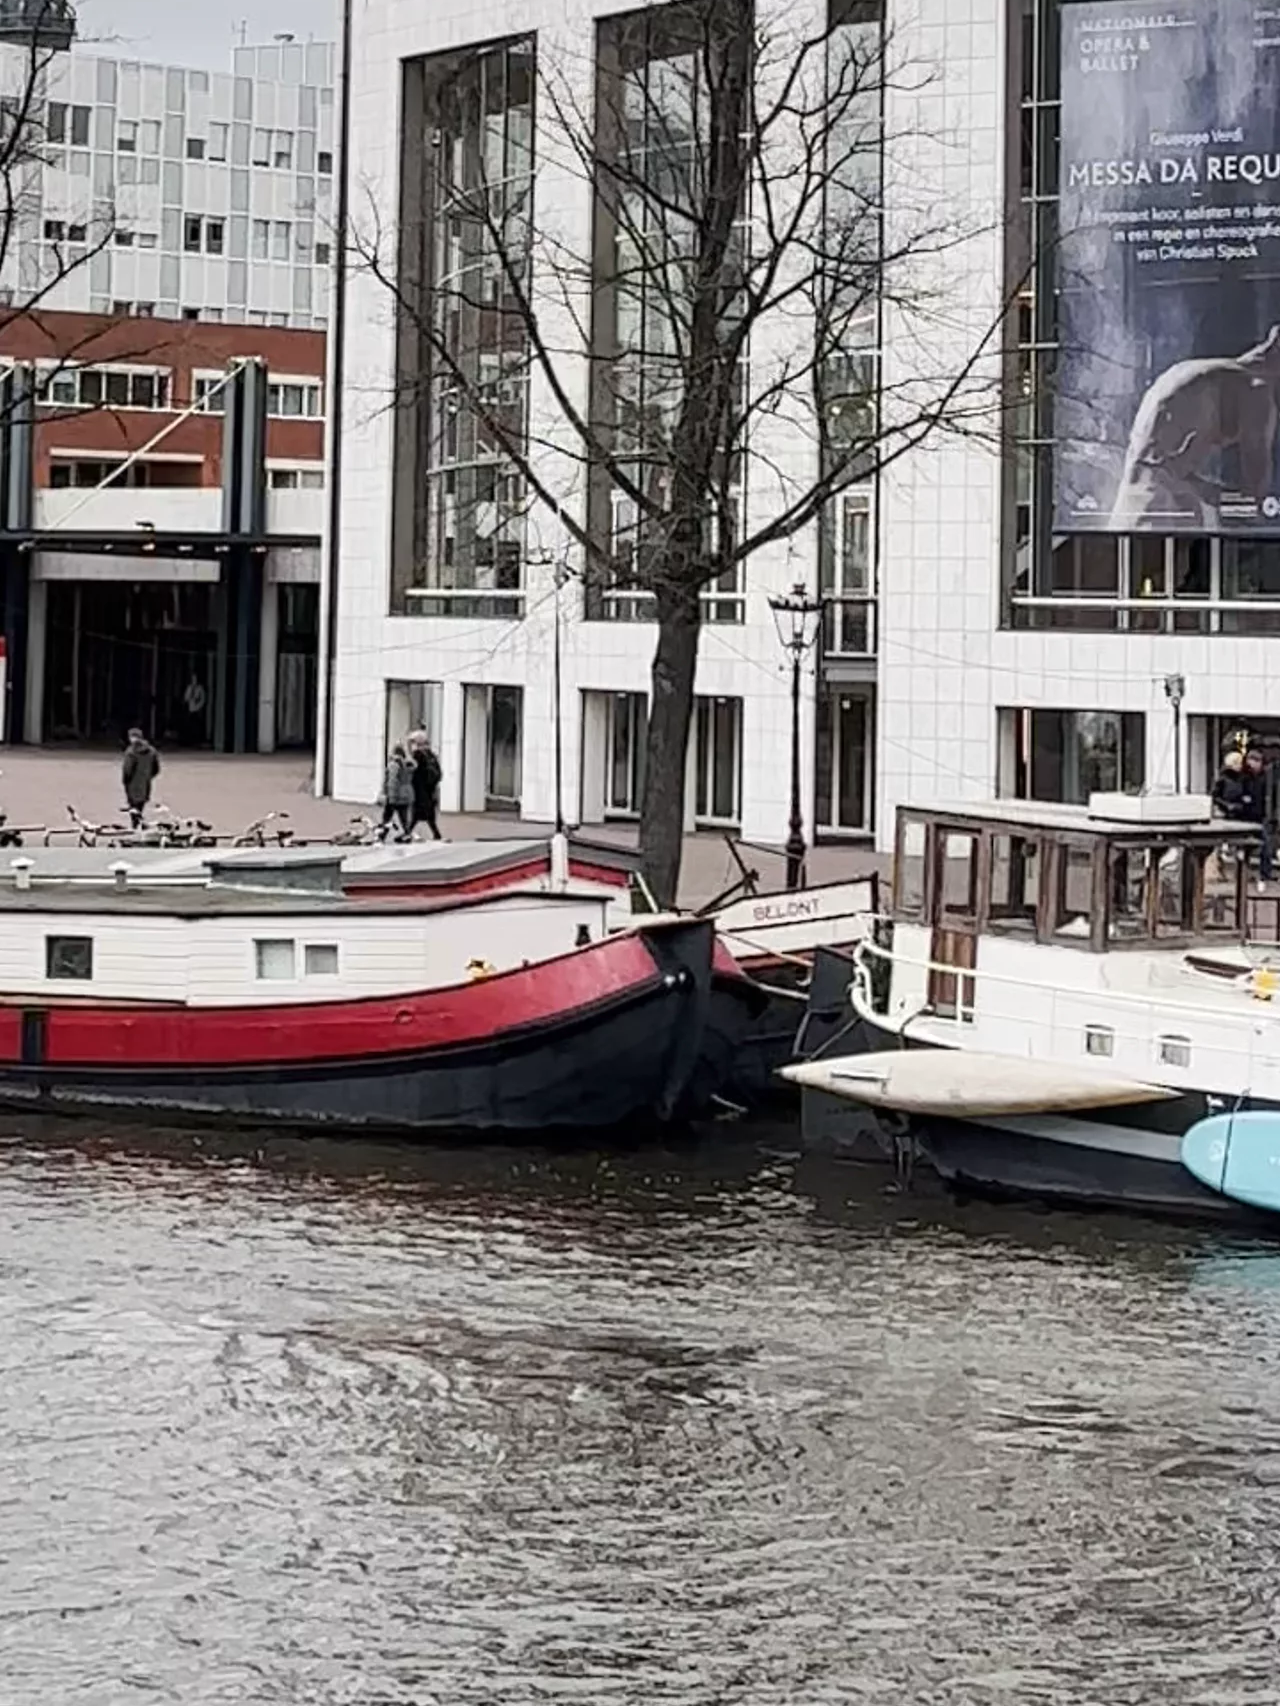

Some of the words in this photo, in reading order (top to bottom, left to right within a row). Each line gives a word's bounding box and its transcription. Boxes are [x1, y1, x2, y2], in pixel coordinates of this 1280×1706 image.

[1080, 36, 1135, 53] OPERA
[1080, 55, 1138, 73] BALLET
[1070, 159, 1152, 186] MESSA
[1160, 157, 1198, 183] DA
